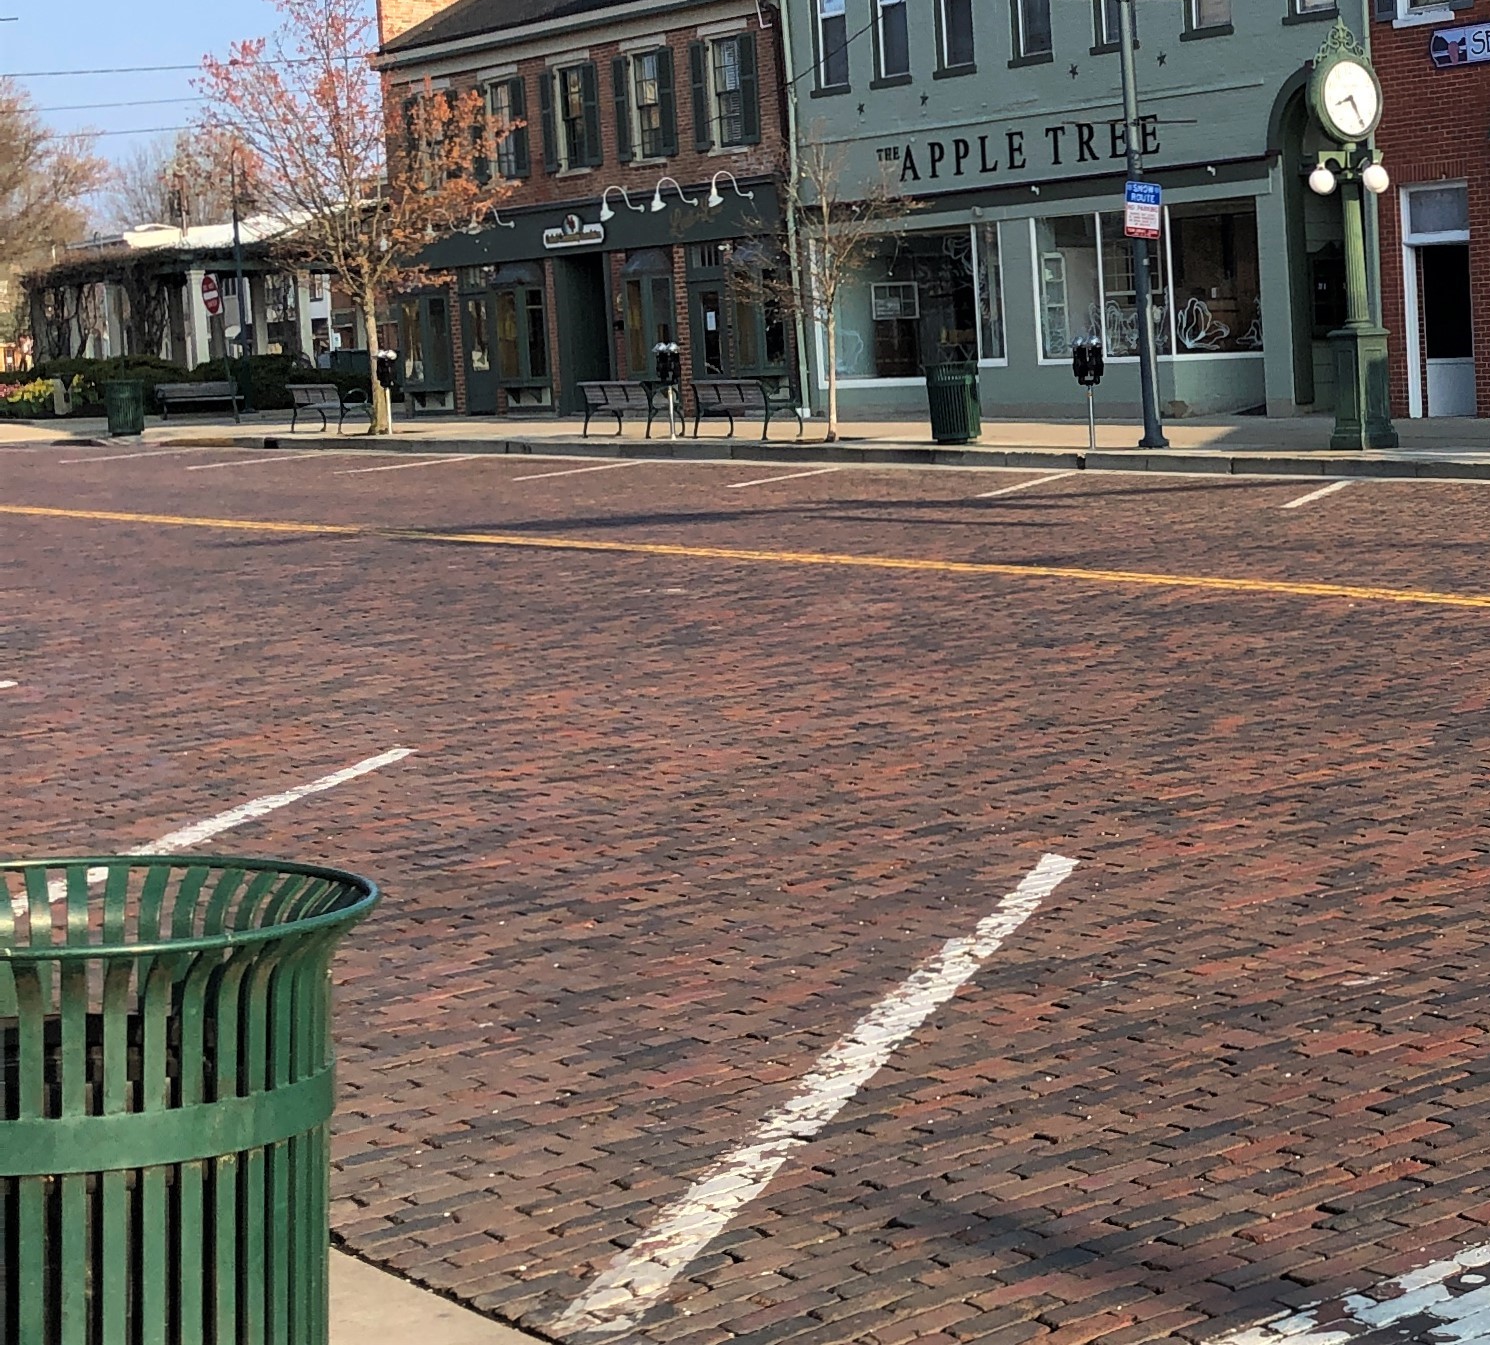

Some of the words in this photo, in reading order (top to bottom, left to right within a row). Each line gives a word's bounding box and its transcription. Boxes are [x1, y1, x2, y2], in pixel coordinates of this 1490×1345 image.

[876, 146, 901, 162] THE
[900, 130, 1026, 182] APPLE
[1045, 114, 1161, 165] TREE
[1133, 184, 1154, 193] SNOW
[1131, 193, 1155, 203] ROUTE
